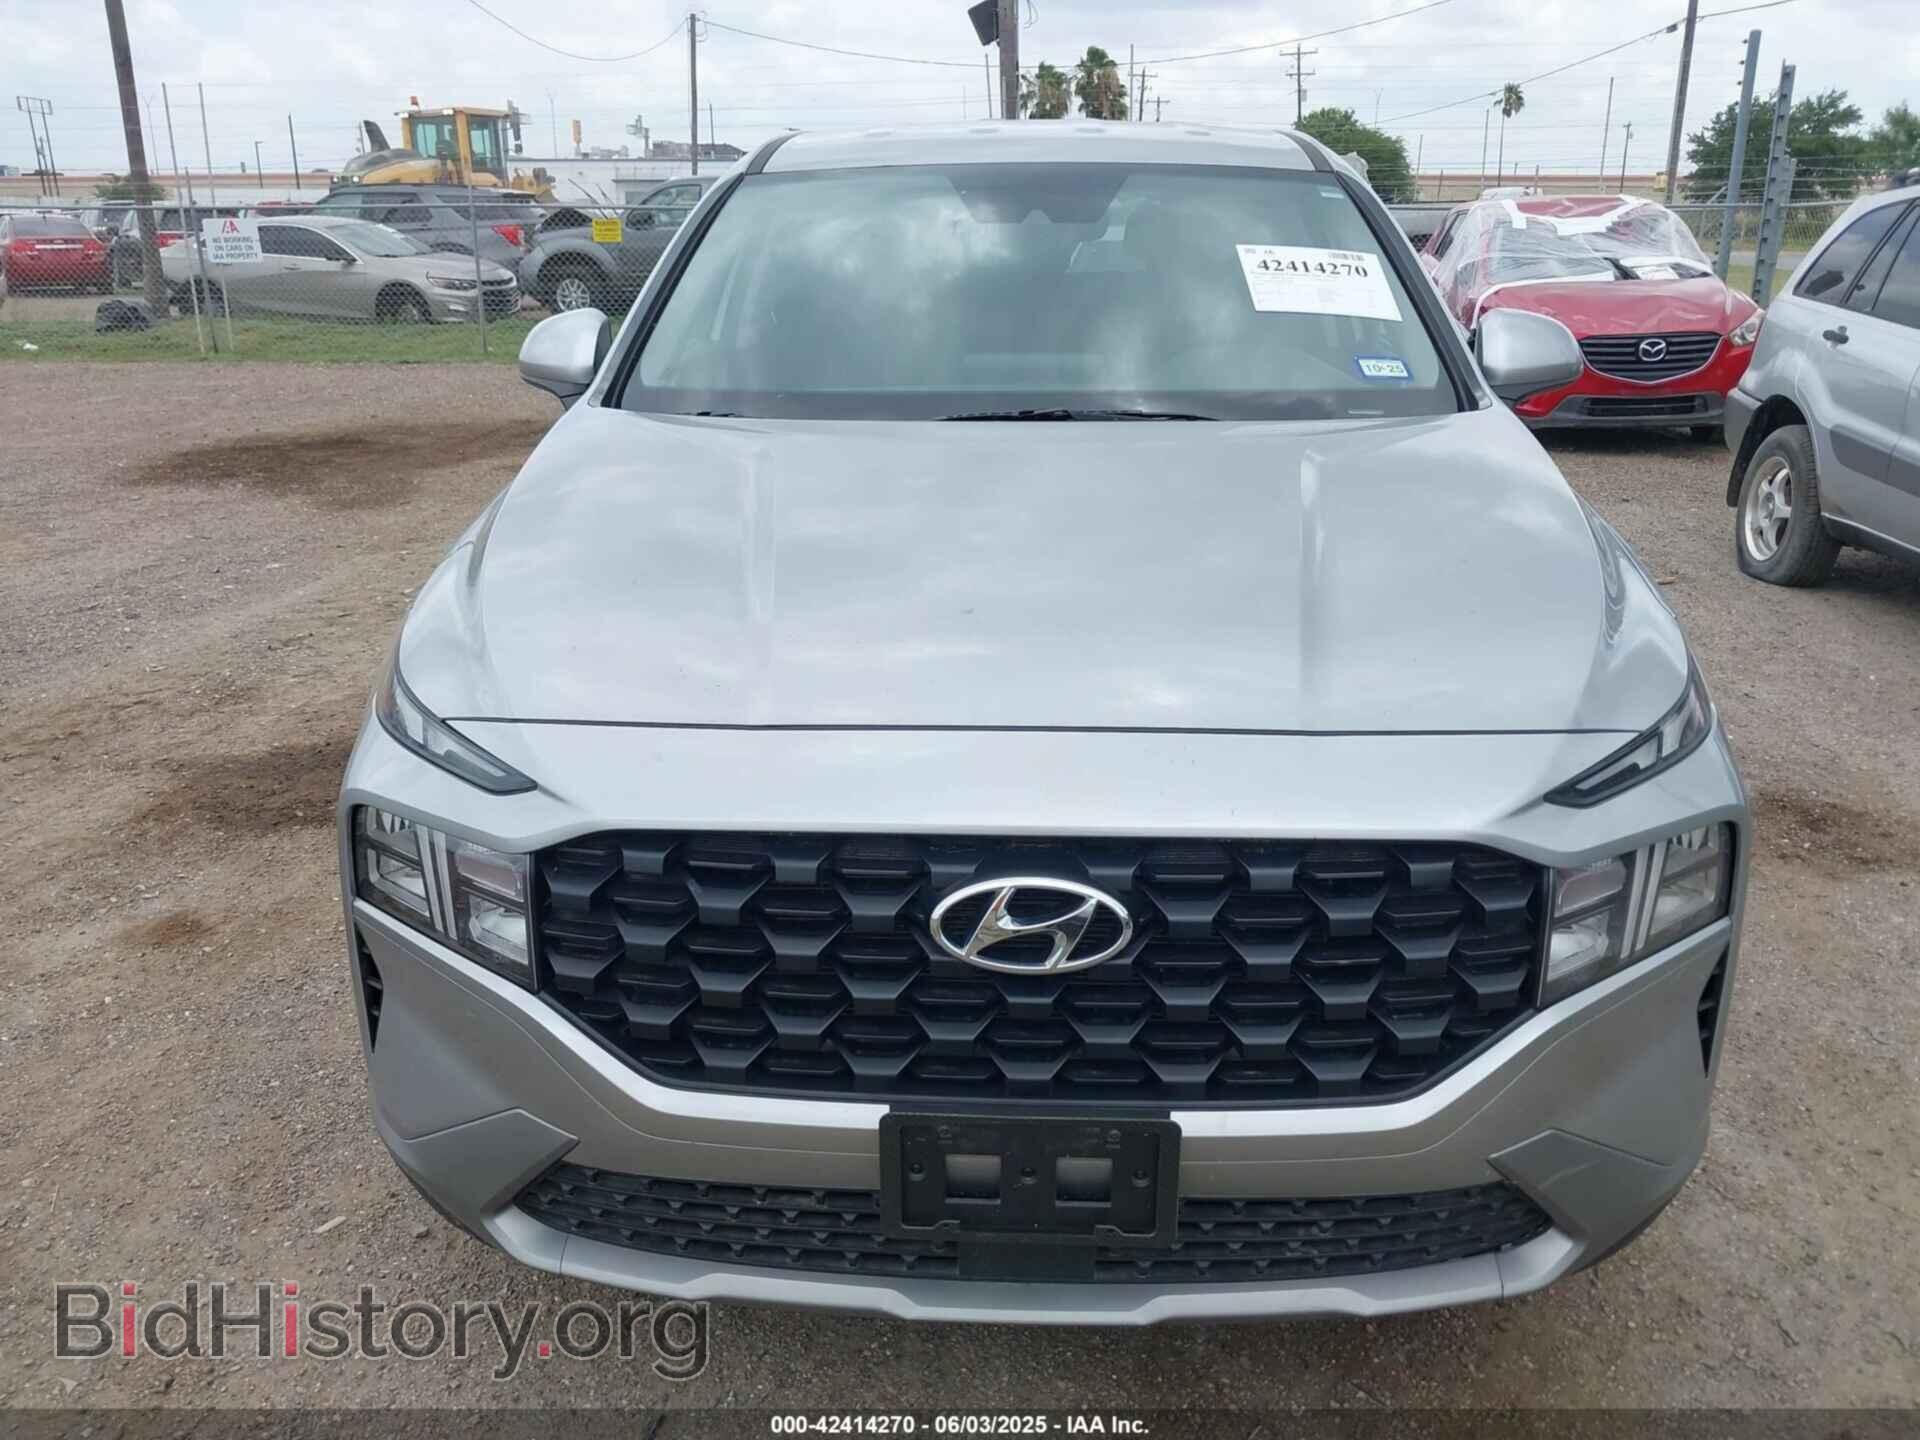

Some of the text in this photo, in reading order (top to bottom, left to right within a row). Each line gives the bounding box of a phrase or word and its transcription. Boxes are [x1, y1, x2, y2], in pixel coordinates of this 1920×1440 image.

[224, 236, 254, 244] WORKING
[225, 244, 243, 252] CARS
[244, 244, 255, 252] ON
[225, 252, 258, 260] PROPERTY
[1257, 258, 1368, 278] 42414270
